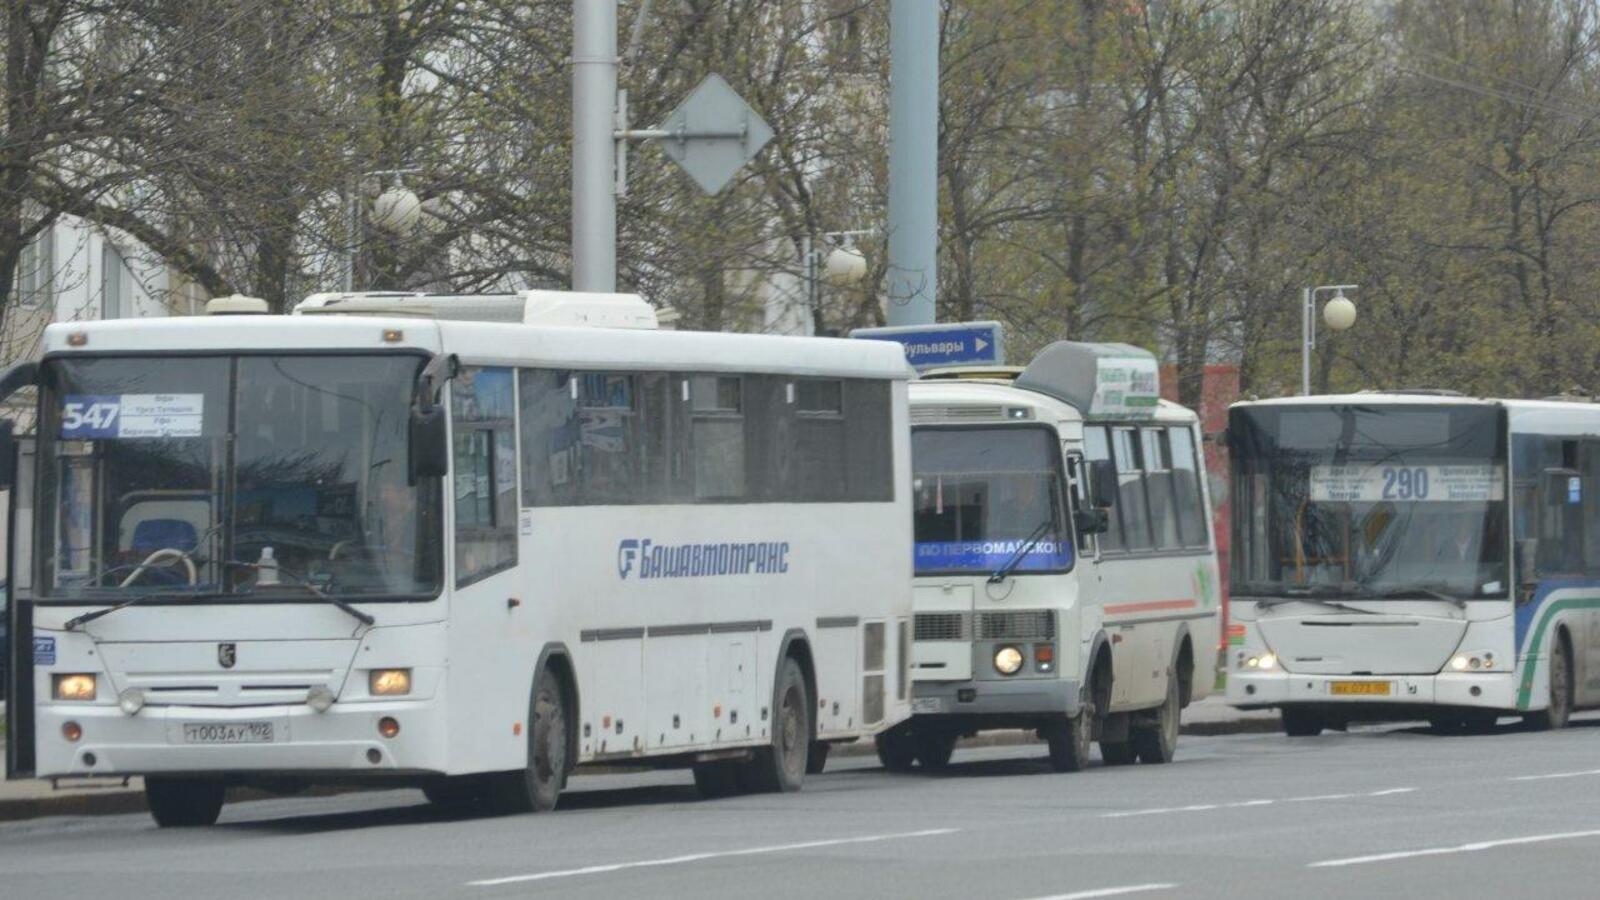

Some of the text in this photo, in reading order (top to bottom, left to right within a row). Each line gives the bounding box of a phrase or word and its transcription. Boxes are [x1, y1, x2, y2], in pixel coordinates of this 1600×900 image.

[903, 341, 964, 358] бульвары
[63, 402, 120, 430] 547
[1382, 467, 1430, 499] 290
